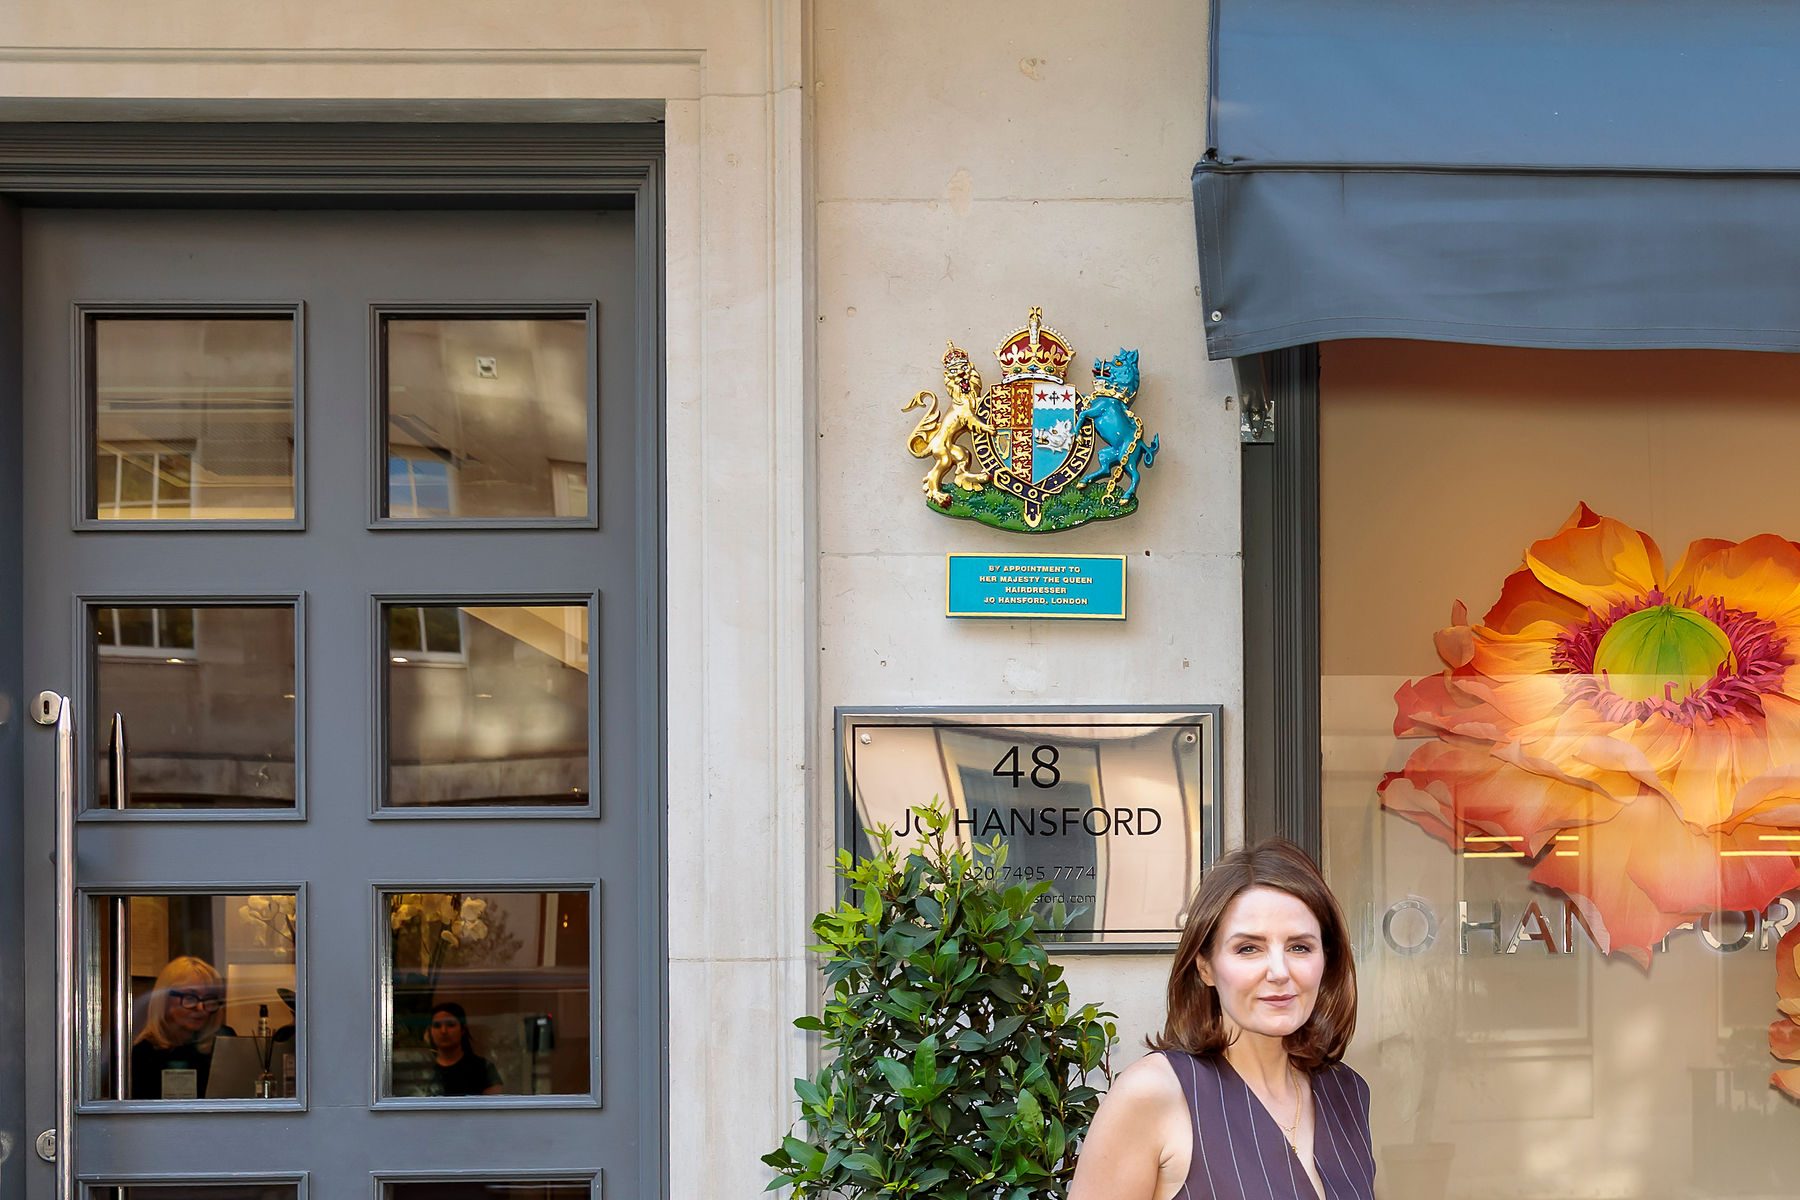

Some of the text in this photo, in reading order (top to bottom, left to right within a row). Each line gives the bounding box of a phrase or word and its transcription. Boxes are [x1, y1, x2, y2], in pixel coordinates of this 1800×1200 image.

[989, 565, 1081, 574] BY APPOINTMENT TO
[979, 575, 997, 583] HER
[1000, 576, 1040, 584] MAJESTY
[1043, 576, 1060, 584] THE
[1005, 586, 1067, 594] HAIRDRESSER
[1051, 597, 1088, 605] LONDON
[992, 744, 1062, 789] 48
[894, 807, 1162, 837] JO HANSFORD
[1003, 866, 1045, 881] 7495
[1053, 866, 1096, 881] 7774
